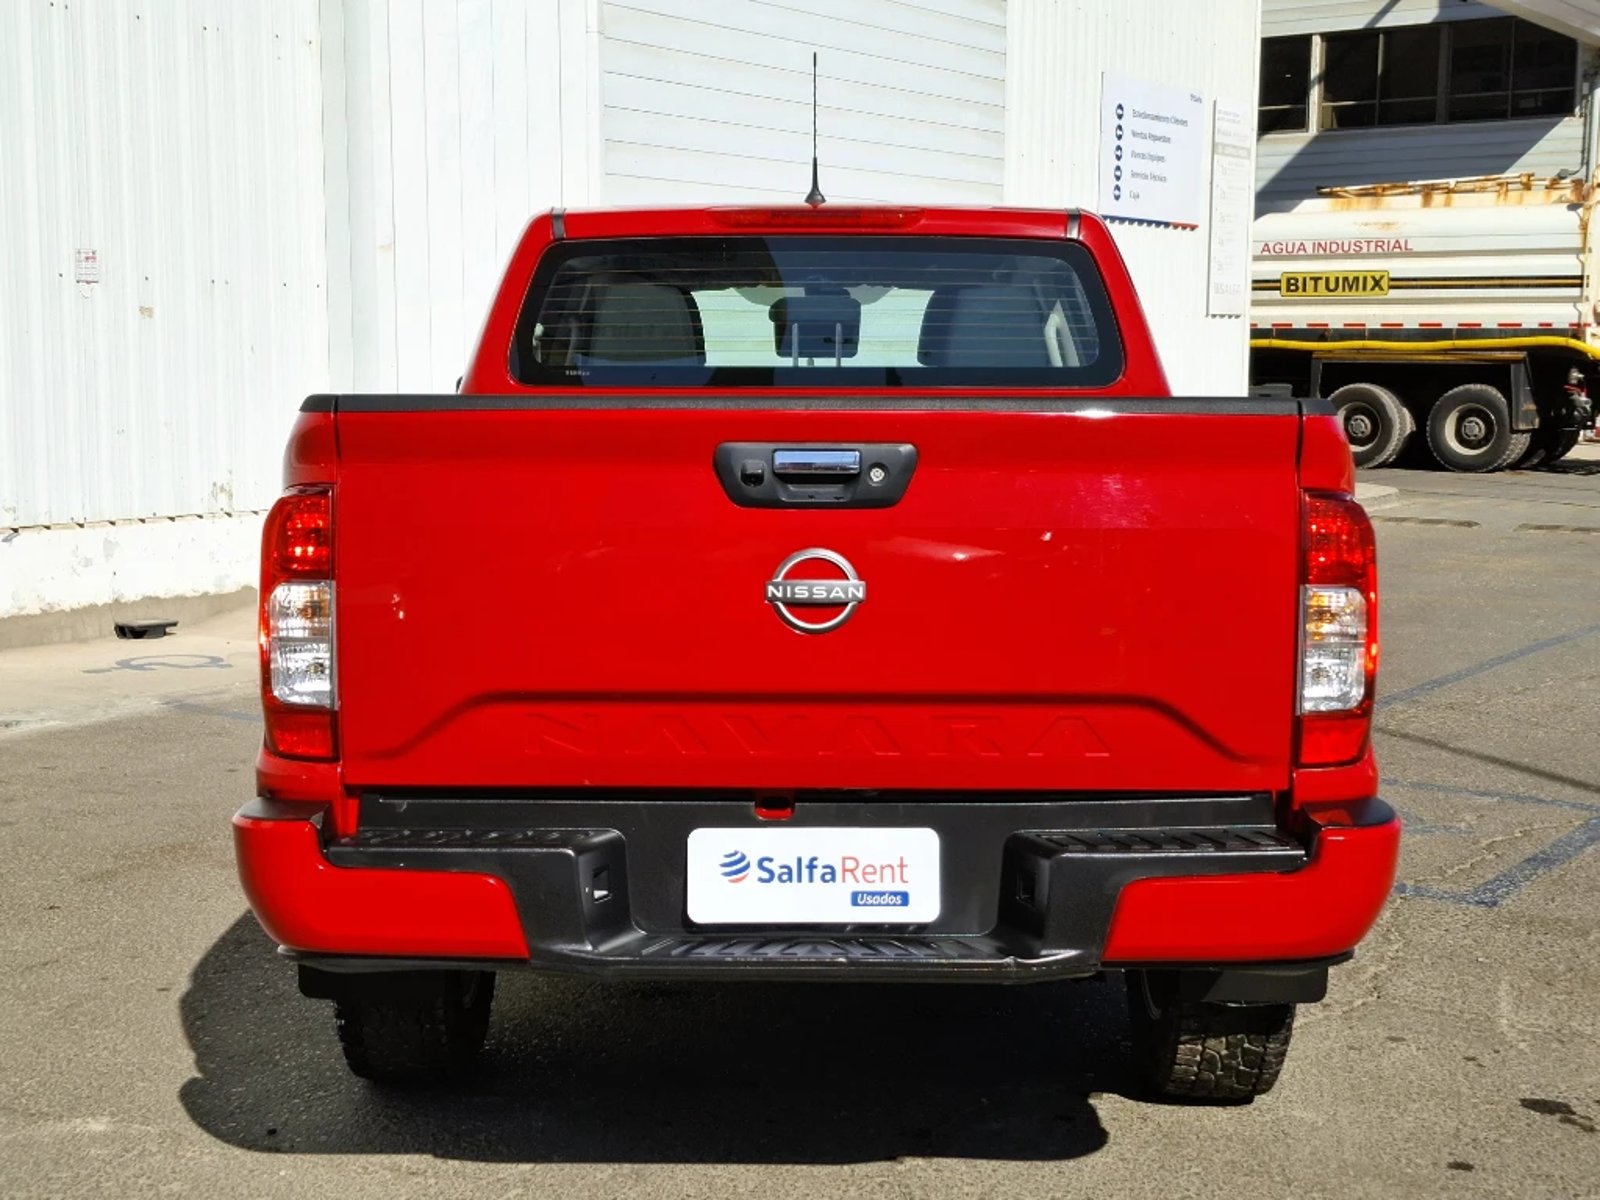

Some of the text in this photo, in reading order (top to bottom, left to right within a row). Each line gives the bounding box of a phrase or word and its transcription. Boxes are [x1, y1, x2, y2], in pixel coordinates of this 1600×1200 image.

[1260, 239, 1413, 254] AGUA INDUSTRIAL
[1285, 275, 1385, 293] BITUMIX
[767, 585, 864, 599] NISSAN
[524, 713, 1111, 757] NAVARA
[856, 892, 904, 905] Usados
